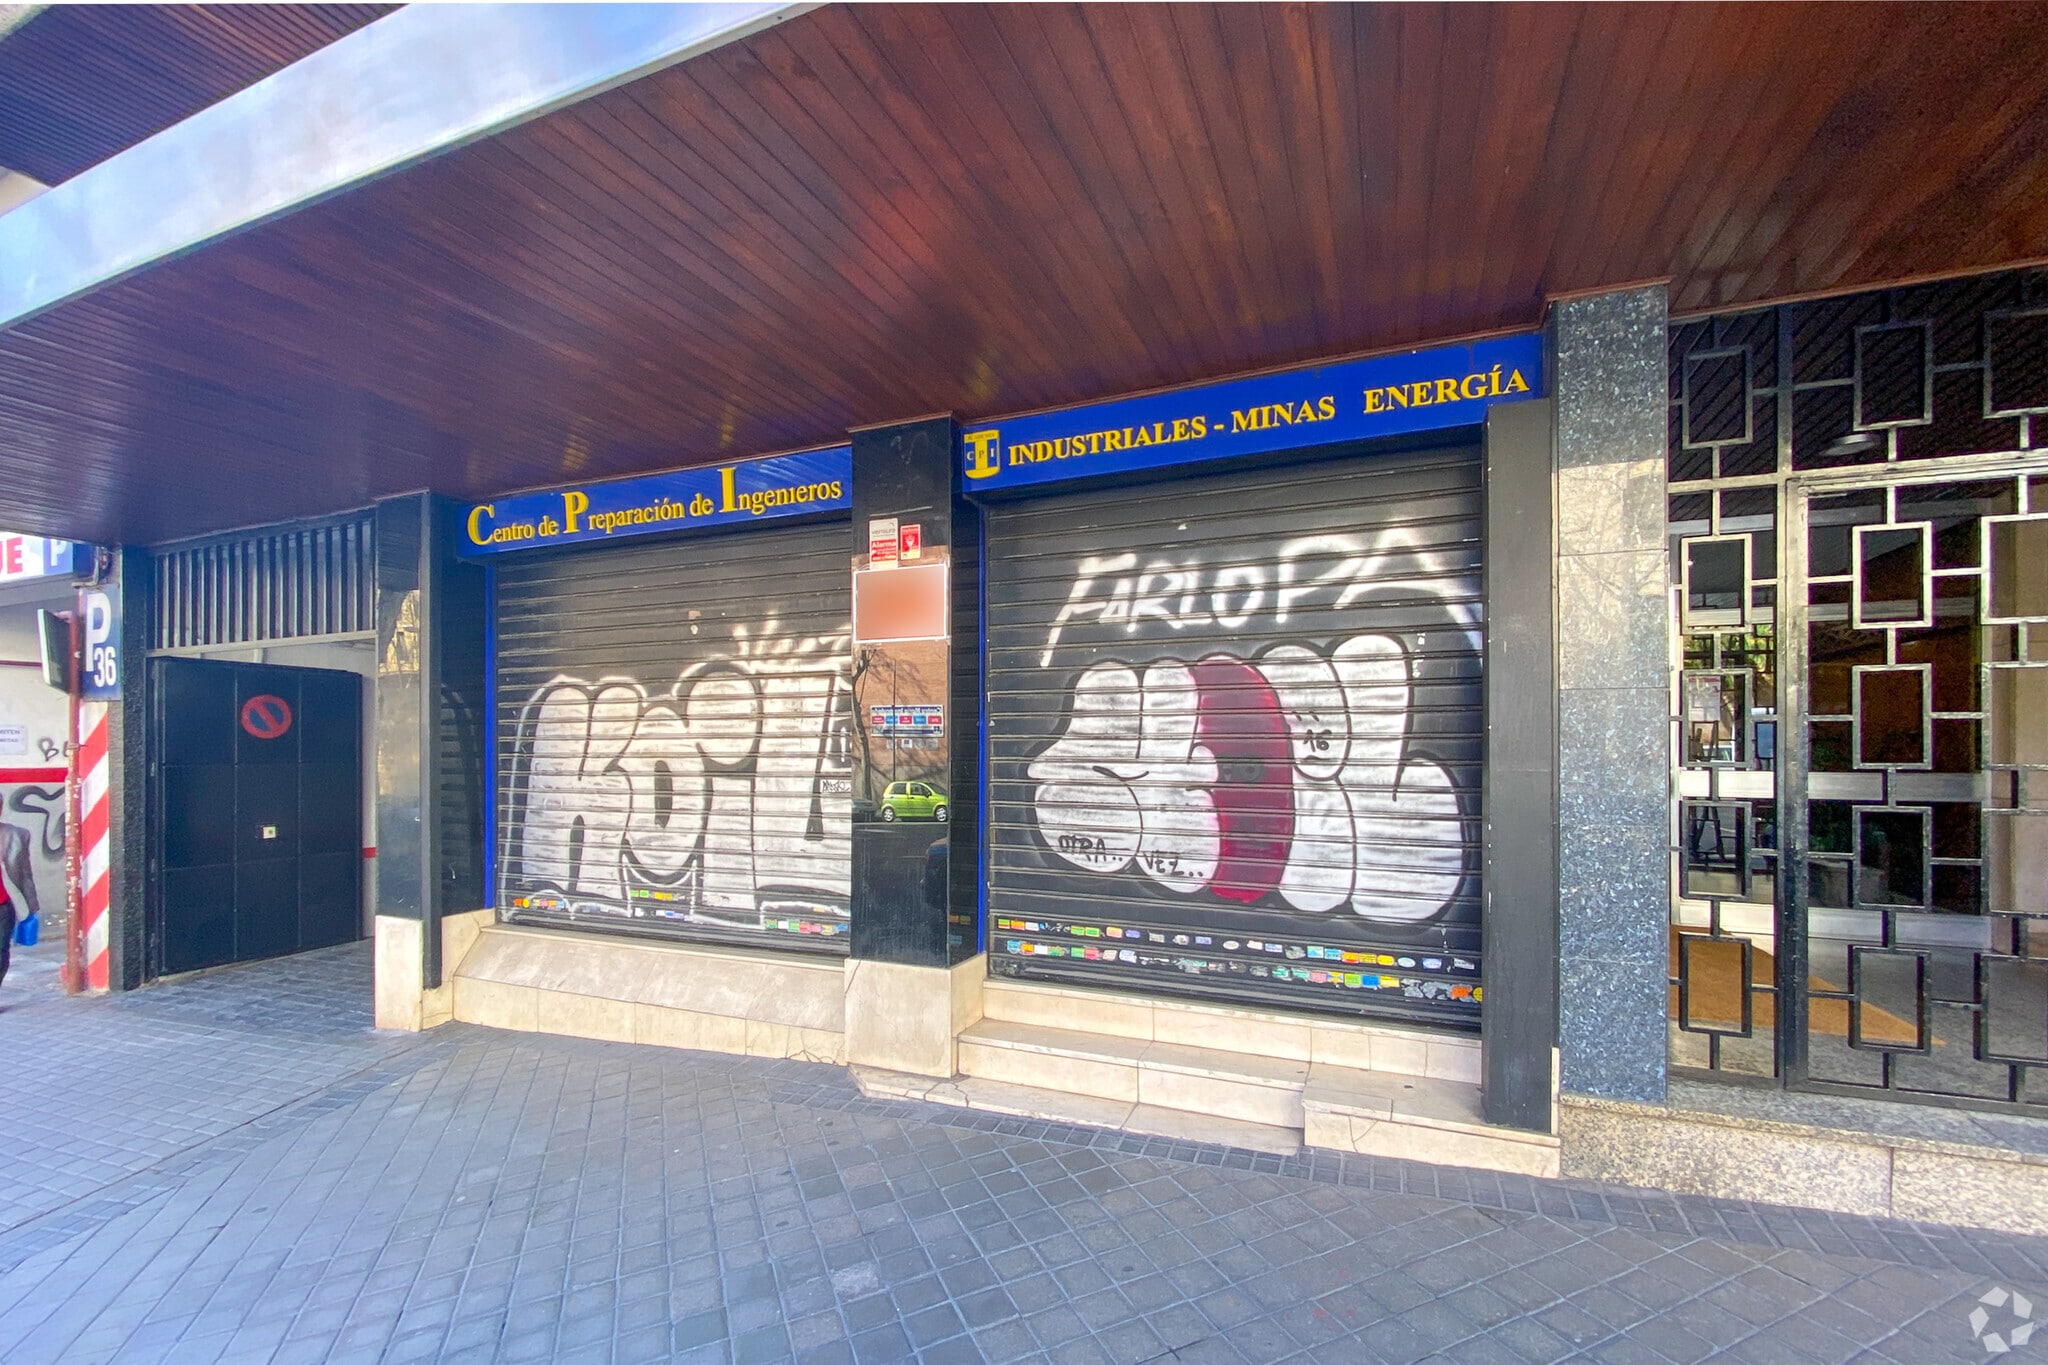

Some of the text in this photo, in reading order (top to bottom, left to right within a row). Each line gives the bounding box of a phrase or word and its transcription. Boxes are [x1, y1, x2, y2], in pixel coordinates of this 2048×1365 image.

[1008, 415, 1207, 467] INDUSTRIALES
[1231, 395, 1336, 434] MINAS
[1363, 364, 1530, 415] ENERGÍA
[467, 466, 843, 546] Centro de Preparación de Ingenieros
[85, 592, 112, 673] P
[93, 646, 117, 688] 36
